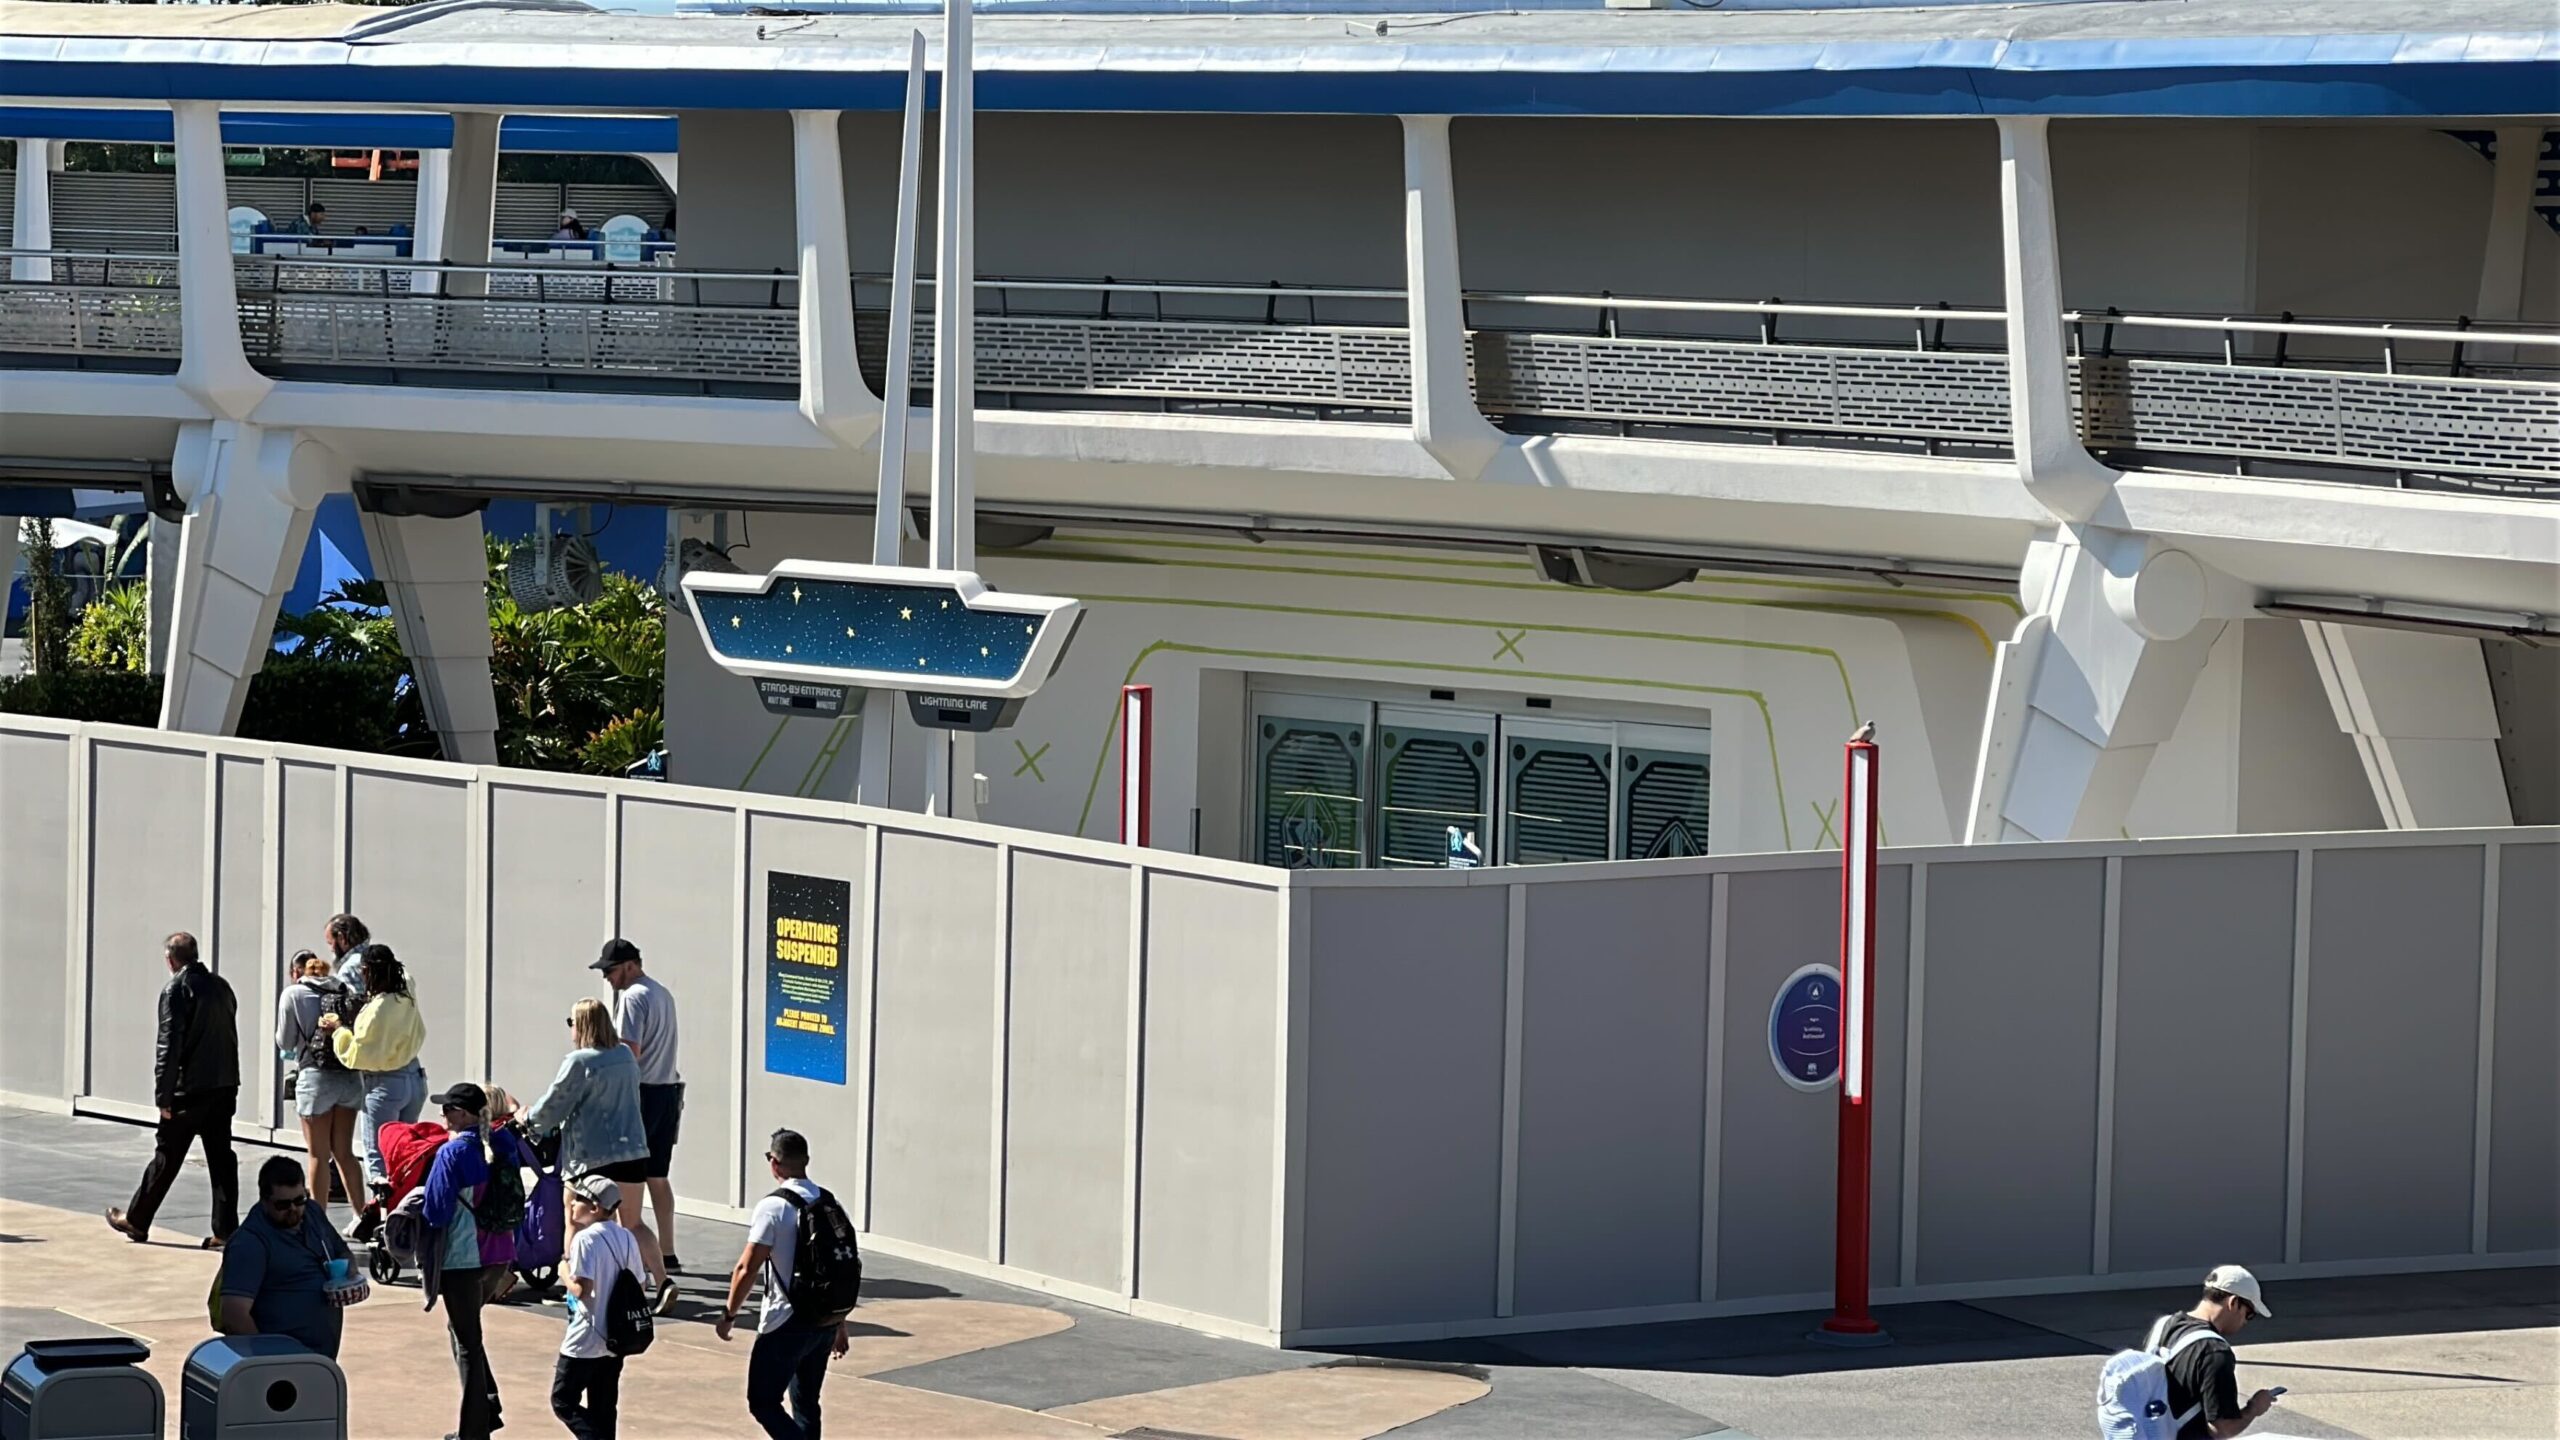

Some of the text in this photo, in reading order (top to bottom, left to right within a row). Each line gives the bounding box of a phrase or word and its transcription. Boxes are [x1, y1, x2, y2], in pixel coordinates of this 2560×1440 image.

[761, 682, 842, 698] STAND-BY ENTRANCE
[920, 695, 989, 710] LIGHTNING LANE
[776, 916, 838, 945] OPERATIONS
[776, 939, 838, 968] SUSPENDED
